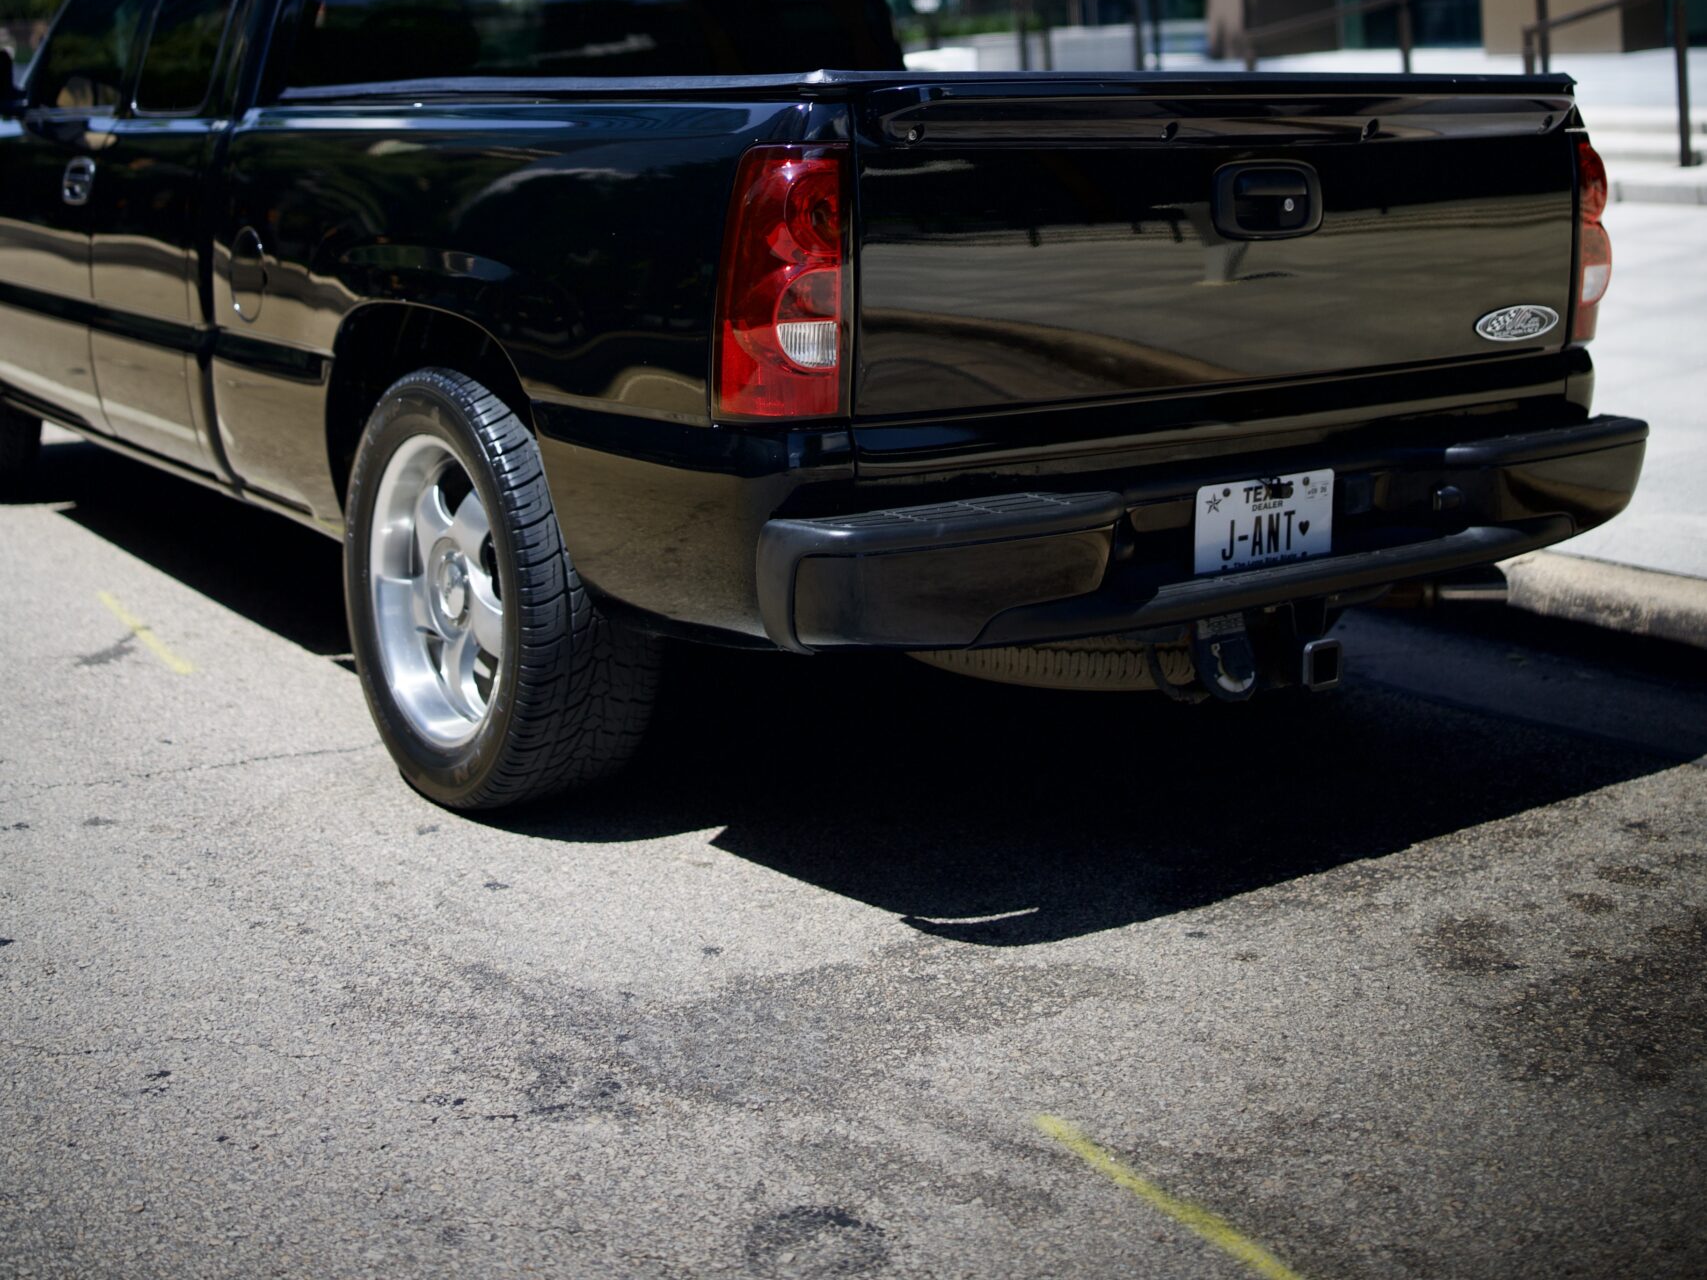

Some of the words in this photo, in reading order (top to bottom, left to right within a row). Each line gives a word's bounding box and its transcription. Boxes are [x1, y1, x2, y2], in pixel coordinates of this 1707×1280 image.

[1243, 481, 1293, 503] TEXS
[1252, 500, 1283, 512] DEALER
[1221, 510, 1296, 561] J-ANT
